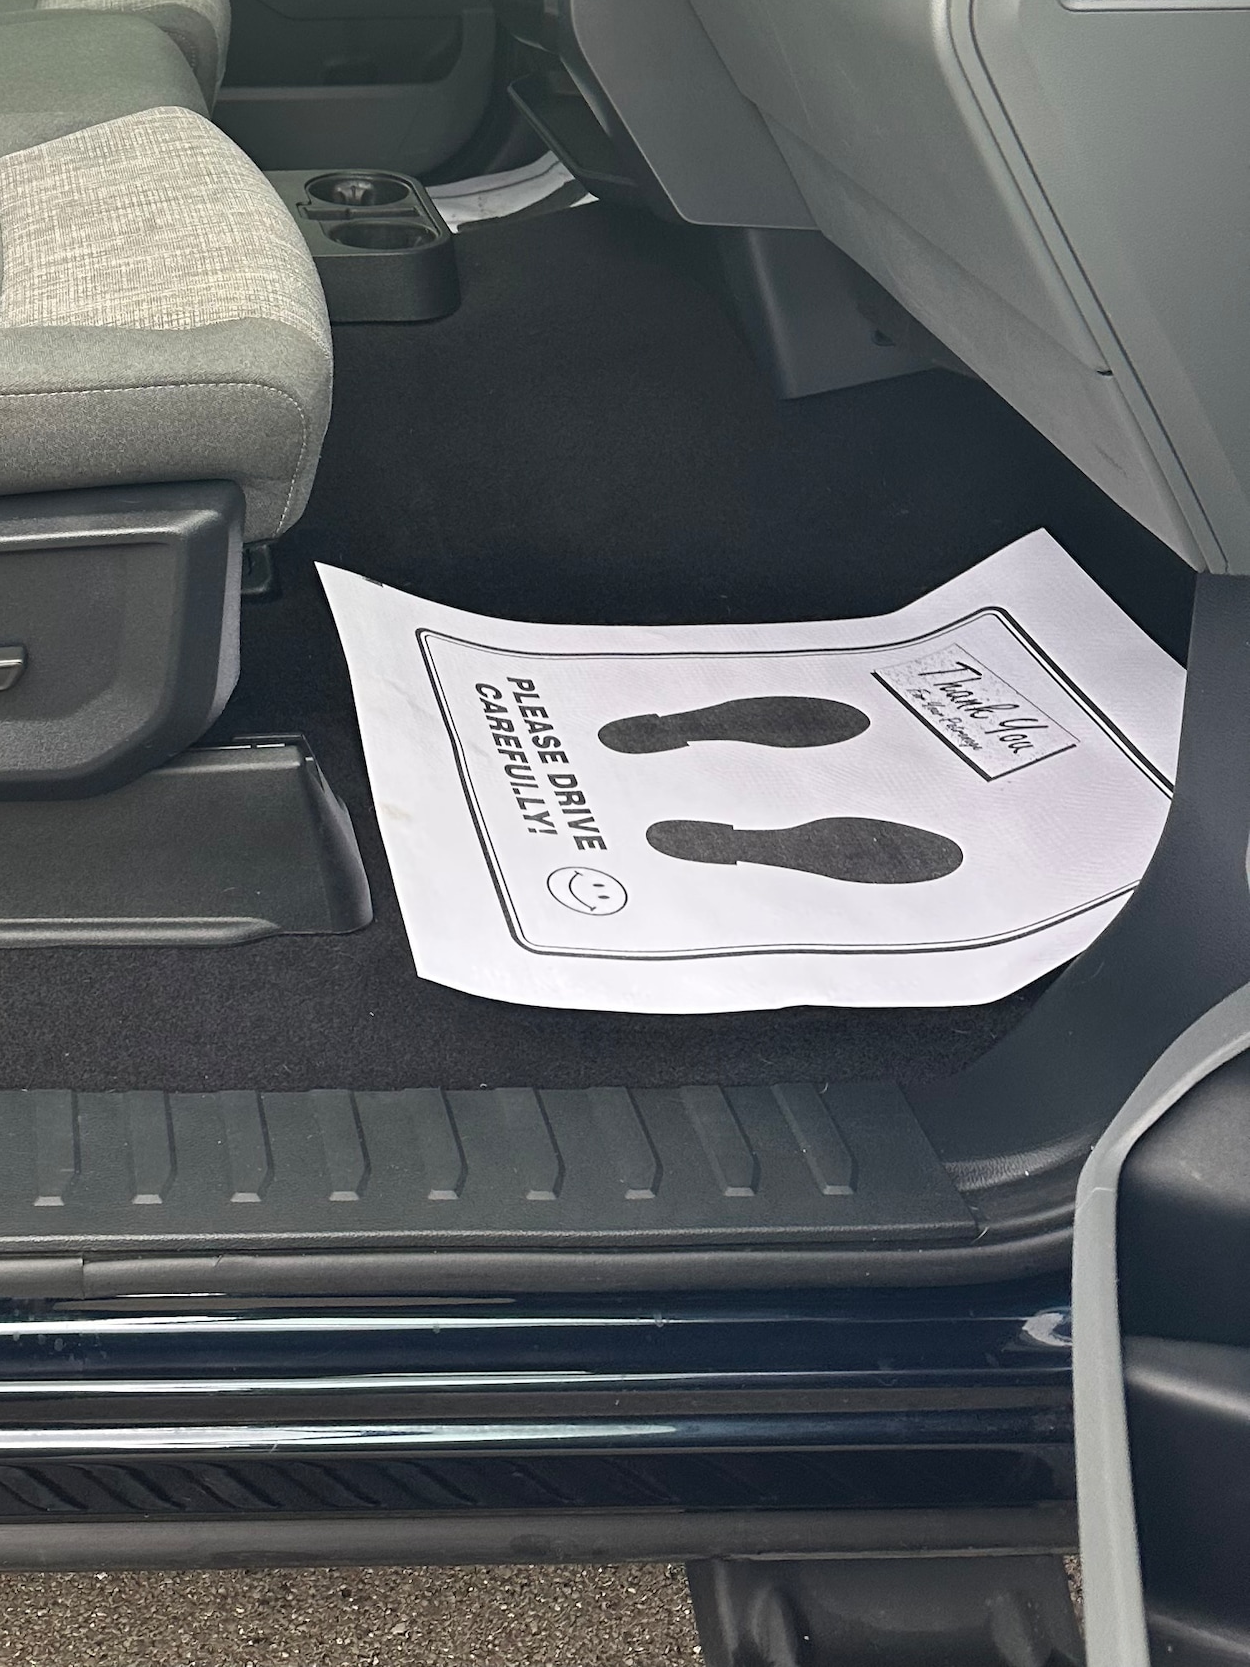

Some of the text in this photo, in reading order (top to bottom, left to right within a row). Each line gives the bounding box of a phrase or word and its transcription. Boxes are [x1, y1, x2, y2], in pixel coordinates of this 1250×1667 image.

[475, 683, 559, 836] CAREFULLY!
[506, 676, 608, 851] PLEASE DRIVE
[918, 661, 1049, 754] Thank You
